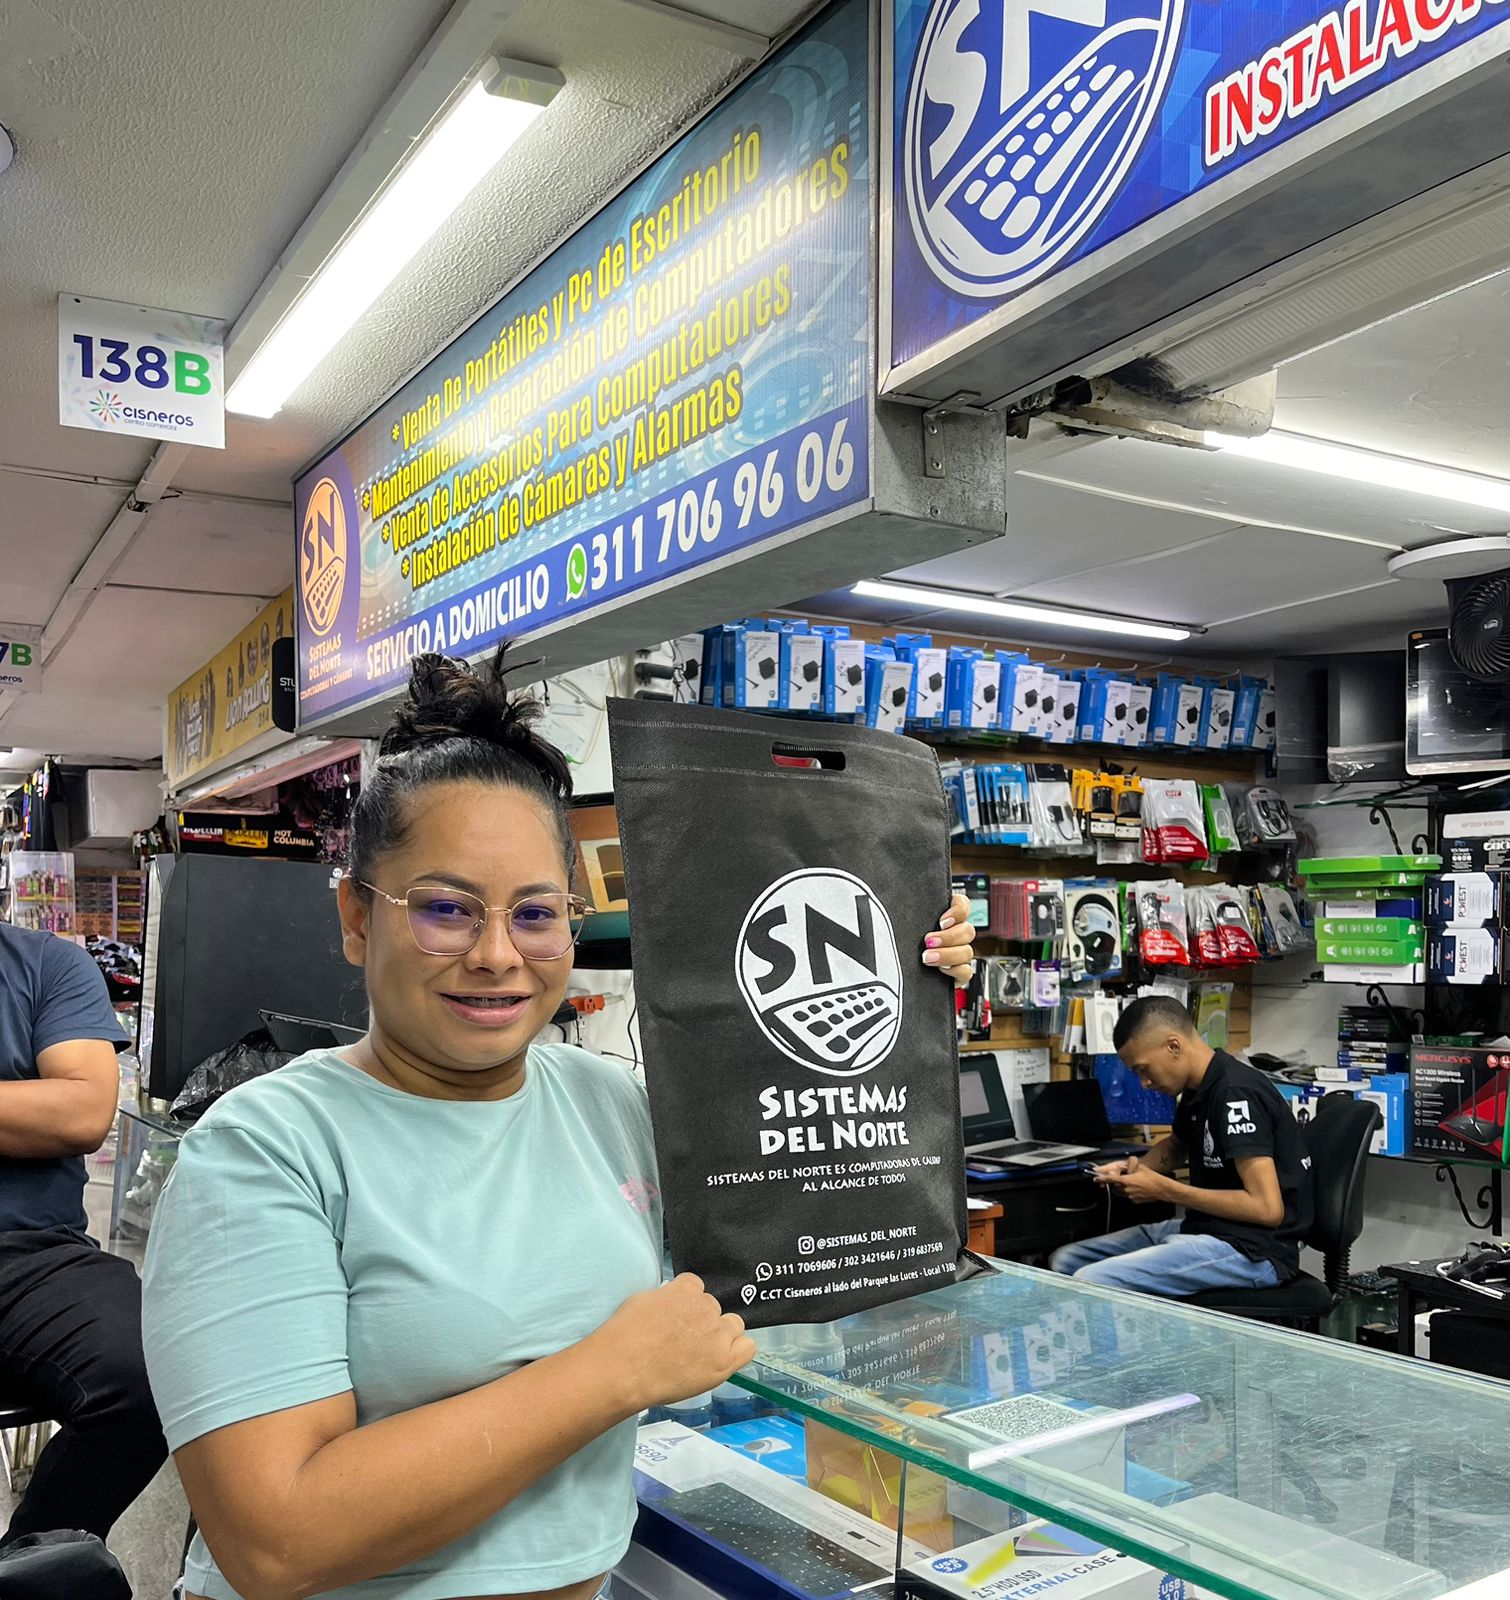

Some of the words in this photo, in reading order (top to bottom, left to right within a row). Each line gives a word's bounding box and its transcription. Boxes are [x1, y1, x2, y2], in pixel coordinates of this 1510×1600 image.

[1207, 0, 1478, 162] INSTALAC
[401, 393, 441, 451] Venta
[444, 375, 462, 419] De
[465, 304, 549, 402] Portátiles
[552, 291, 564, 342] y
[568, 269, 593, 324] Pc
[598, 243, 625, 300] de
[631, 131, 761, 274] Escritorio
[371, 418, 475, 521] Mantenimiento
[475, 408, 487, 453] y
[488, 327, 597, 439] Reparación
[601, 305, 629, 362] de
[634, 142, 849, 337] Computadores
[72, 333, 212, 396] 138B
[122, 406, 194, 427] cisneros
[390, 499, 430, 553] Venta
[431, 486, 450, 528] de
[452, 426, 543, 517] Accesorios
[547, 395, 593, 457] Para
[597, 263, 791, 426] Computadores
[411, 507, 495, 588] Instalación
[498, 495, 520, 542] de
[523, 444, 611, 528] Cámaras
[615, 433, 629, 487] y
[632, 368, 742, 472] Alarmas
[366, 618, 430, 681] SERVICIO
[433, 612, 447, 651] A
[449, 564, 550, 648] DOMICILIO
[591, 514, 644, 591] 311
[656, 477, 723, 564] 706
[733, 449, 784, 530] 96
[796, 417, 854, 503] 06
[308, 665, 320, 681] DEL
[320, 652, 342, 677] NORTE
[309, 632, 342, 665] SISTEMAS
[745, 894, 878, 995] SN
[759, 1083, 908, 1121] SISTEMAS
[759, 1126, 826, 1156] DEL
[832, 1119, 910, 1150] NORTE
[1227, 1122, 1257, 1135] AMD
[706, 1170, 765, 1187] SISTEMAS
[768, 1169, 790, 1181] DEL
[793, 1164, 832, 1178] NORTE
[835, 1163, 846, 1175] ES
[848, 1158, 911, 1174] COMPUTADORAS
[910, 1157, 922, 1167] DE
[802, 1181, 818, 1193] AL
[820, 1176, 866, 1191] ALCANCE
[868, 1175, 880, 1186] DE
[881, 1173, 907, 1185] TODOS
[817, 1225, 917, 1250] @SISTEMAS_DEL_NORTE
[775, 1263, 794, 1276] 311
[797, 1259, 837, 1274] 7069606
[844, 1255, 859, 1267] 302
[861, 1250, 896, 1264] 3421646
[902, 1246, 915, 1258] 319
[915, 1241, 944, 1256] 6837569
[760, 1288, 783, 1300] C.CT
[784, 1286, 823, 1298] Cisneros
[824, 1282, 831, 1294] al
[832, 1280, 849, 1293] lado
[850, 1278, 862, 1290] del
[863, 1275, 888, 1288] Parque
[889, 1273, 899, 1283] las
[900, 1269, 919, 1281] Luces
[923, 1264, 941, 1277] Local
[997, 1571, 1078, 1600] XTERNAL
[1077, 1554, 1117, 1576] CASE
[1161, 1578, 1181, 1595] USB
